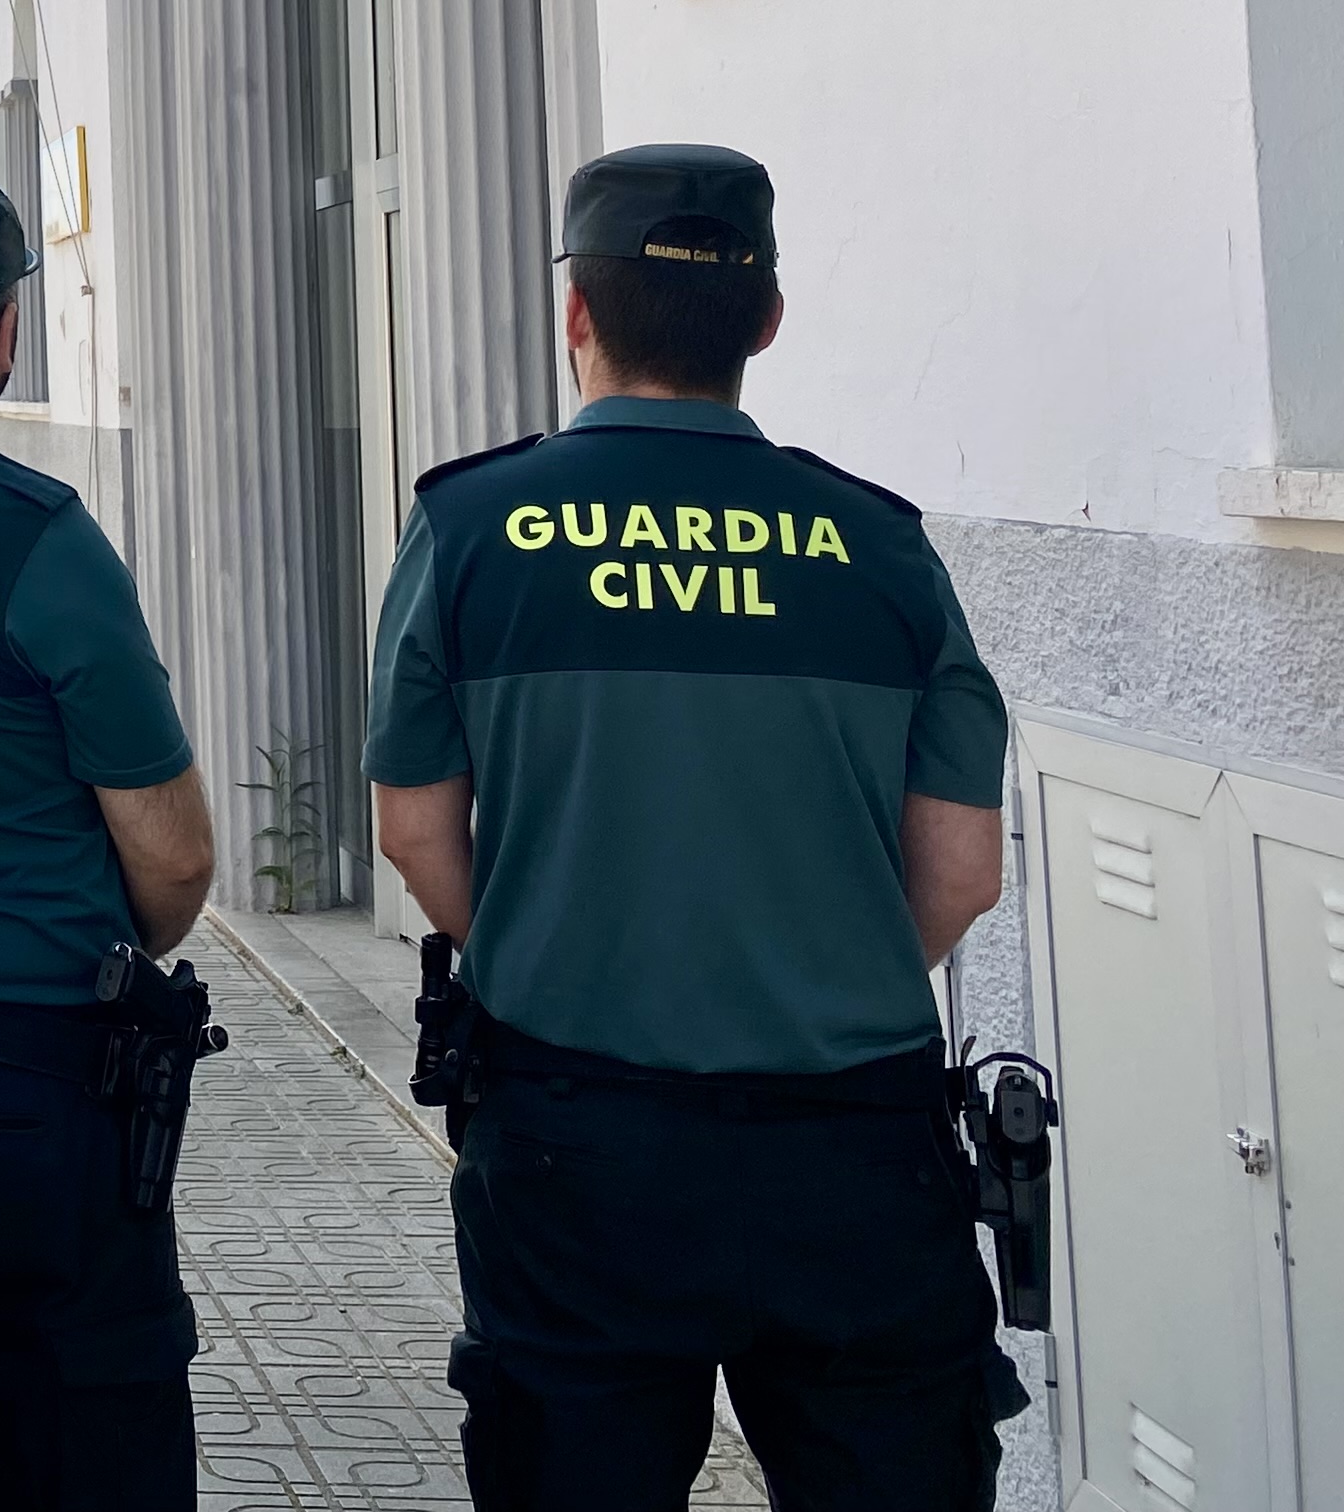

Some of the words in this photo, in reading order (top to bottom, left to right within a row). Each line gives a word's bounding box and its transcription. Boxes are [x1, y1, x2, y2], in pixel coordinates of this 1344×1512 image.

[645, 243, 691, 261] GUARDIA
[693, 249, 720, 263] CIVIL
[505, 502, 851, 564] GUARDIA
[589, 561, 777, 616] CIVIL
